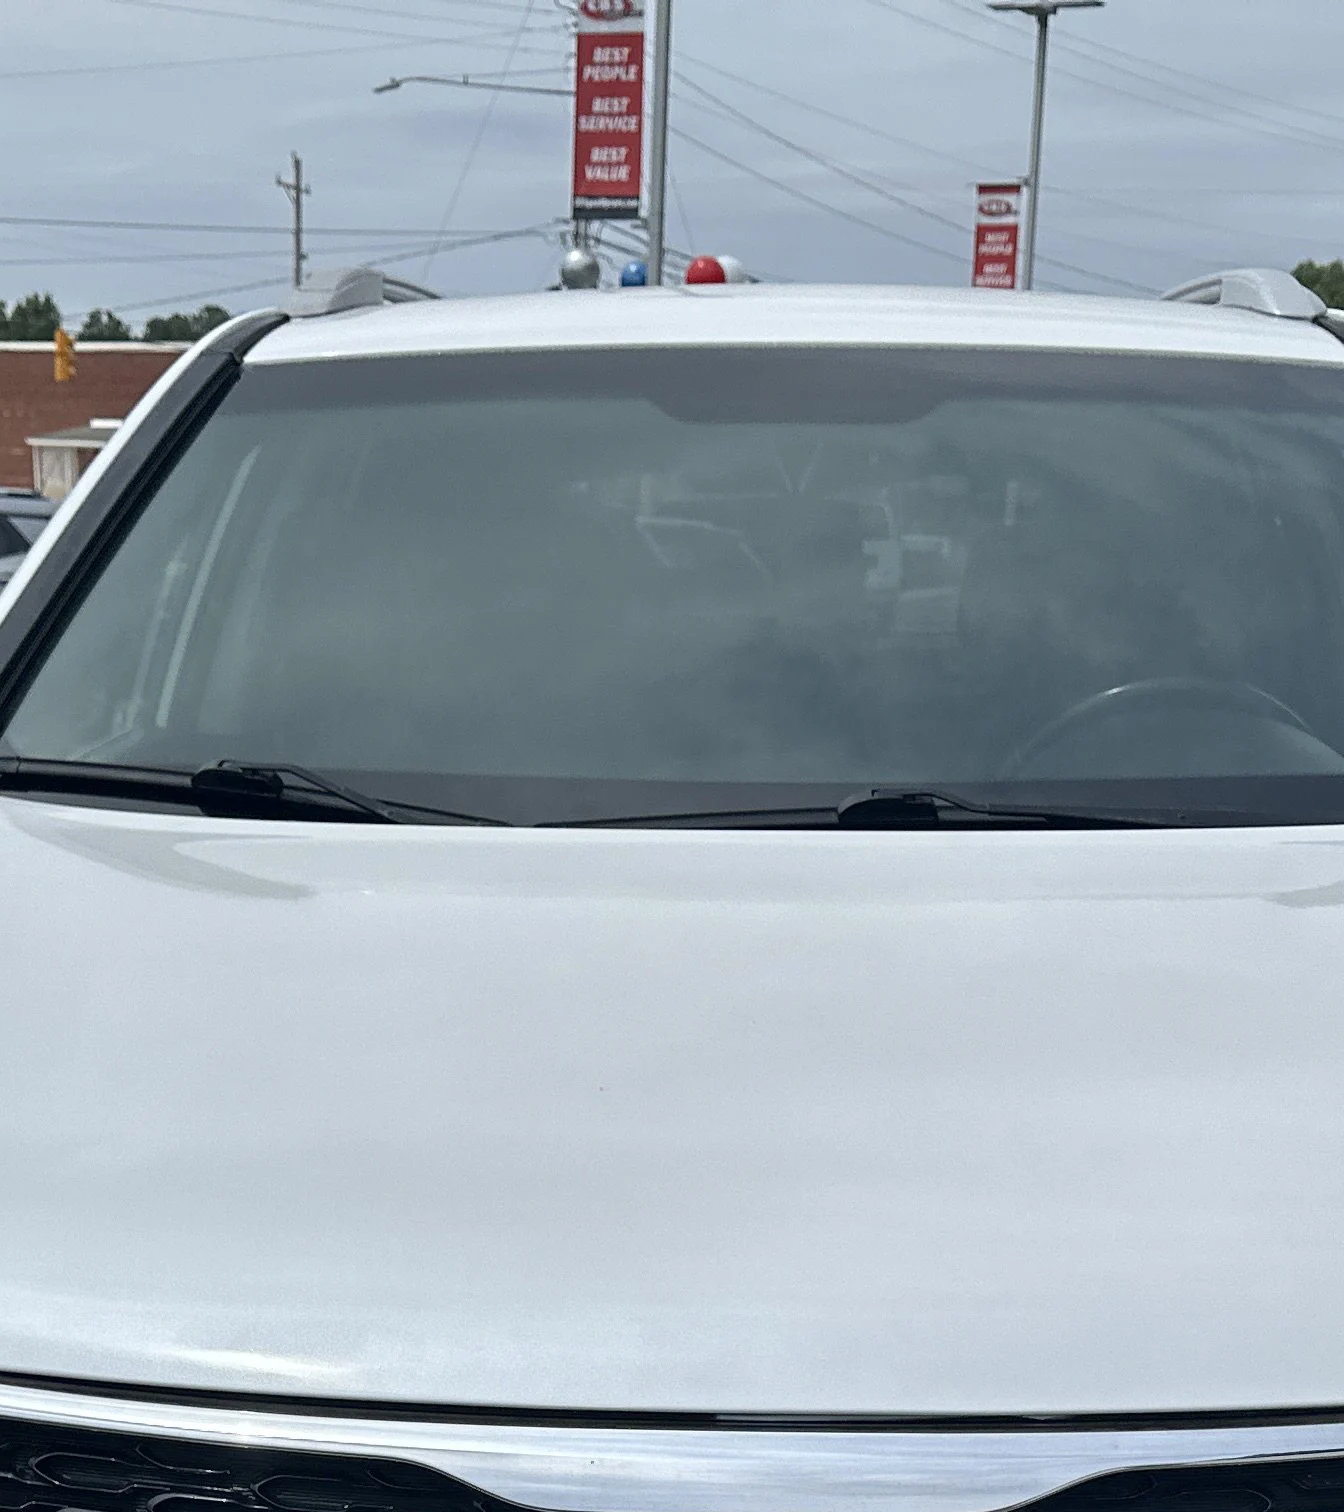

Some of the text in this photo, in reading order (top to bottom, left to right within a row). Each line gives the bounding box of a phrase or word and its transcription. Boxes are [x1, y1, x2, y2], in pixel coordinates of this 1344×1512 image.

[592, 46, 632, 63] BEST
[583, 64, 639, 82] PEOPLE
[591, 96, 630, 113] BEST
[578, 114, 639, 133] SERVICE
[590, 146, 629, 163] BEST
[585, 164, 631, 182] VALUE
